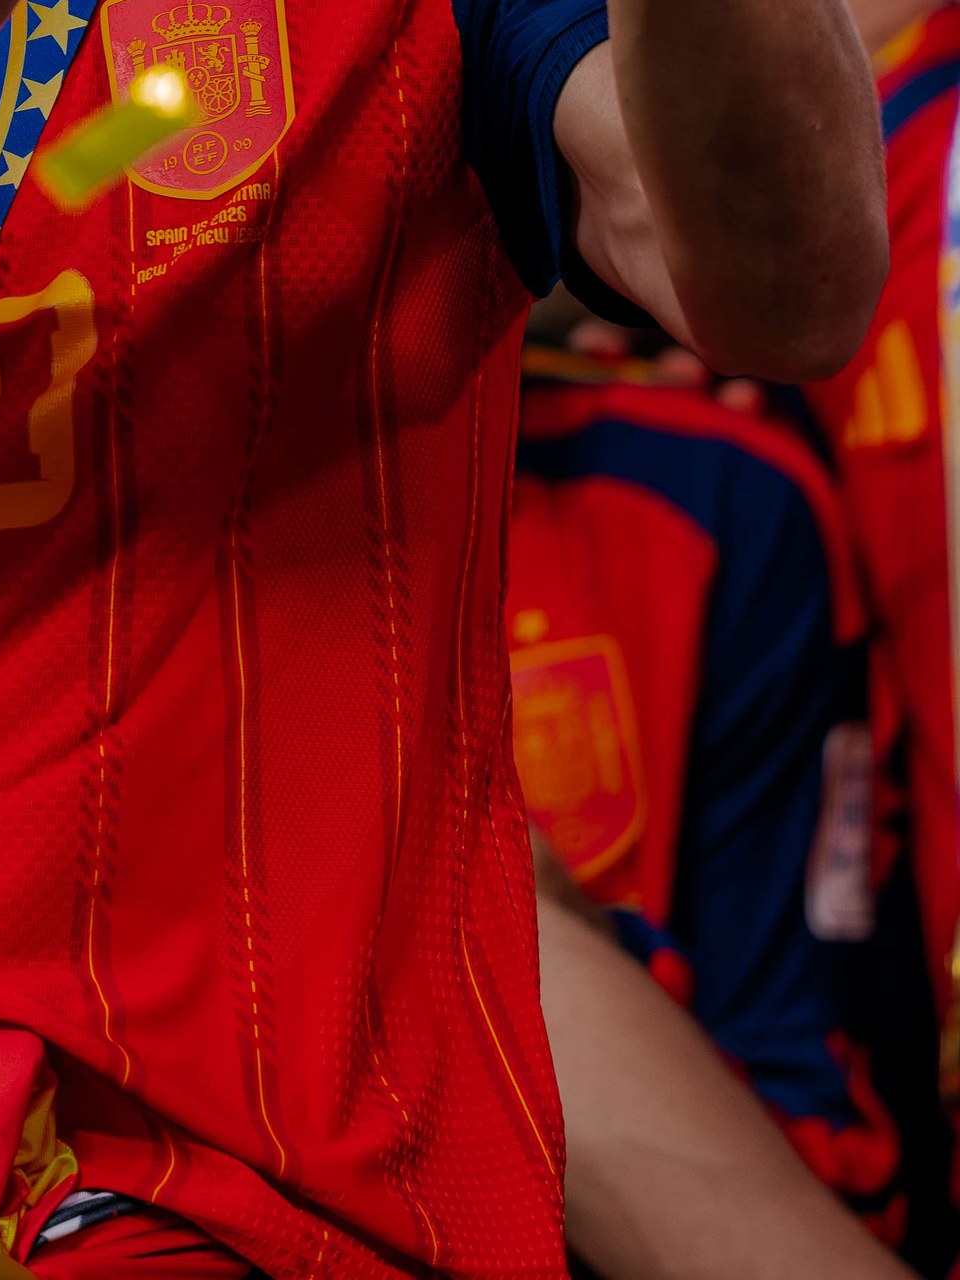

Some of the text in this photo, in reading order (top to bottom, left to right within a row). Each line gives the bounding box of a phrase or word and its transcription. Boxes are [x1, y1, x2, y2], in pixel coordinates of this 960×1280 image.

[232, 137, 253, 152] 09
[162, 155, 178, 171] 19
[146, 226, 188, 247] SPAIN
[196, 226, 229, 247] NEW
[136, 263, 168, 285] NEW
